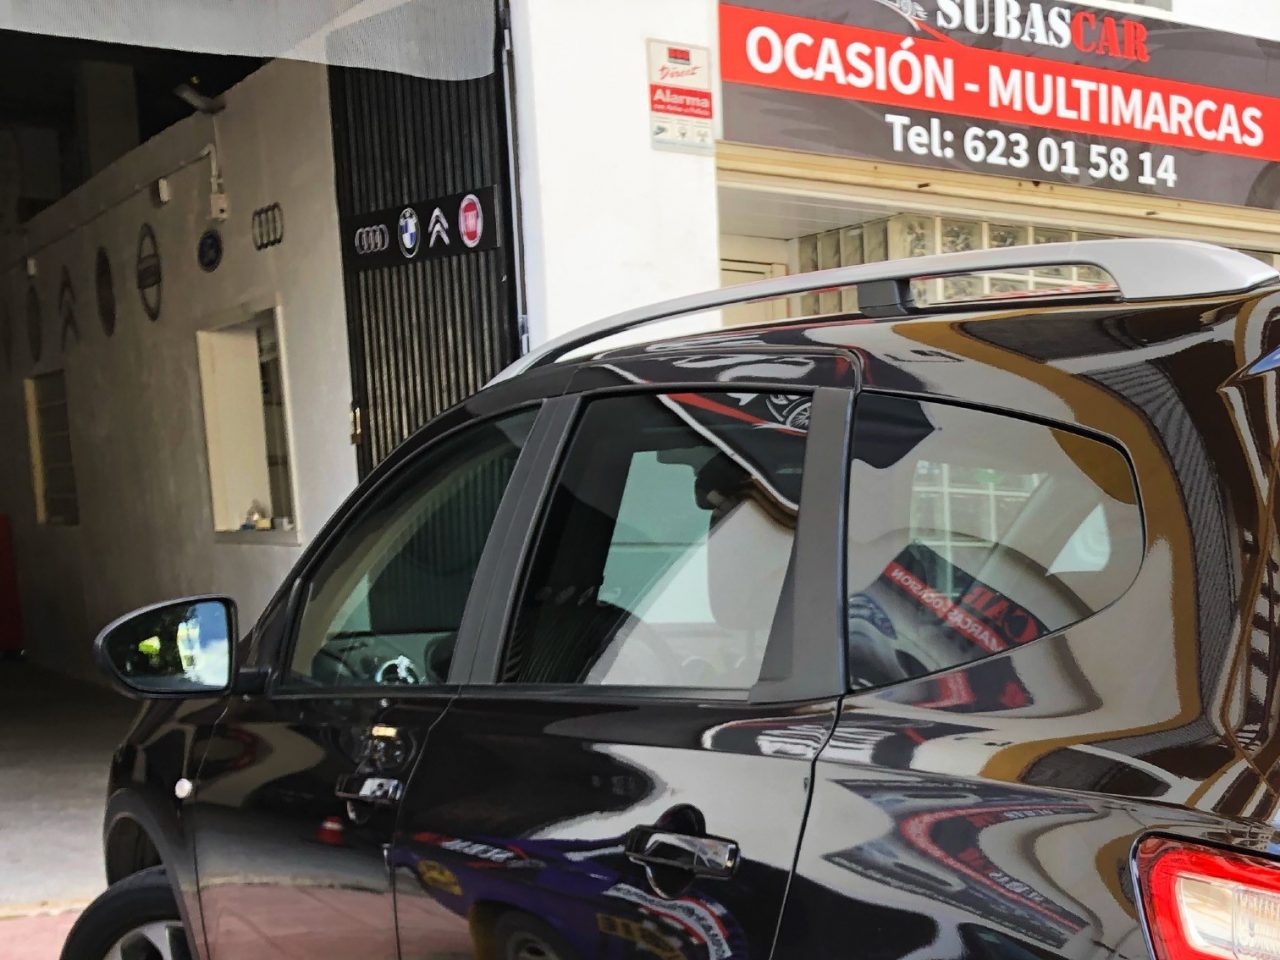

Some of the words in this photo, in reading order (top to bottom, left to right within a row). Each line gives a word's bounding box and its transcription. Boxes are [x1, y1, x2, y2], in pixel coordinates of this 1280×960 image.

[937, 0, 1150, 62] SUBASCAR
[653, 88, 710, 107] Alarma
[746, 37, 955, 101] OCASIÓN
[988, 65, 1264, 147] MULTIMARCAS
[885, 114, 954, 159] Tel:
[963, 127, 1030, 168] 623
[1037, 137, 1080, 175] 01
[1088, 144, 1130, 182] 58
[1138, 151, 1178, 188] 14
